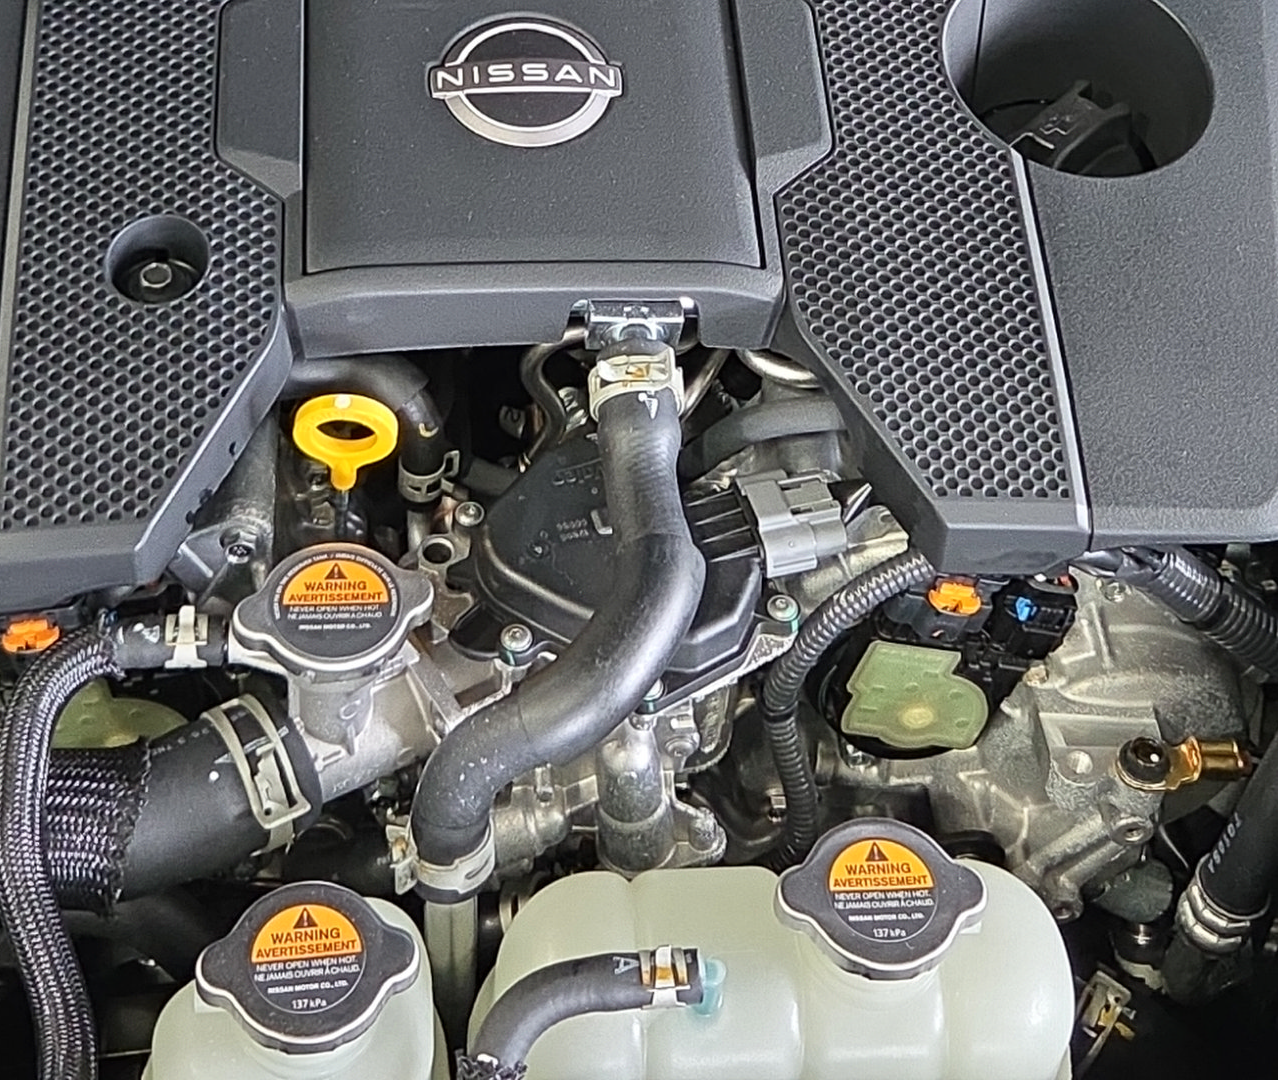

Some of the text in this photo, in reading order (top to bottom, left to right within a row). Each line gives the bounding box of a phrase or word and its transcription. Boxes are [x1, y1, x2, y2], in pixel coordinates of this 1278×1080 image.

[437, 63, 616, 89] NISSAN
[304, 581, 367, 592] WARNING
[288, 592, 383, 602] AVERTISSEMENT
[339, 604, 363, 612] WHEN
[845, 863, 911, 875] WARNING
[833, 875, 928, 888] AVERTISSEMENT
[835, 892, 861, 900] NEVER
[862, 892, 885, 900] OPEN
[886, 891, 911, 899] WHEN
[871, 900, 900, 908] OUVRIR
[271, 928, 340, 944] WARNING
[873, 928, 907, 938] 137 kPa
[256, 940, 357, 958] AVERTISSEMENT
[256, 962, 284, 972] NEVER
[285, 960, 310, 970] OPEN
[311, 957, 337, 968] WHEN
[294, 968, 323, 978] OUVRIR
[292, 998, 327, 1010] 137 kPa
